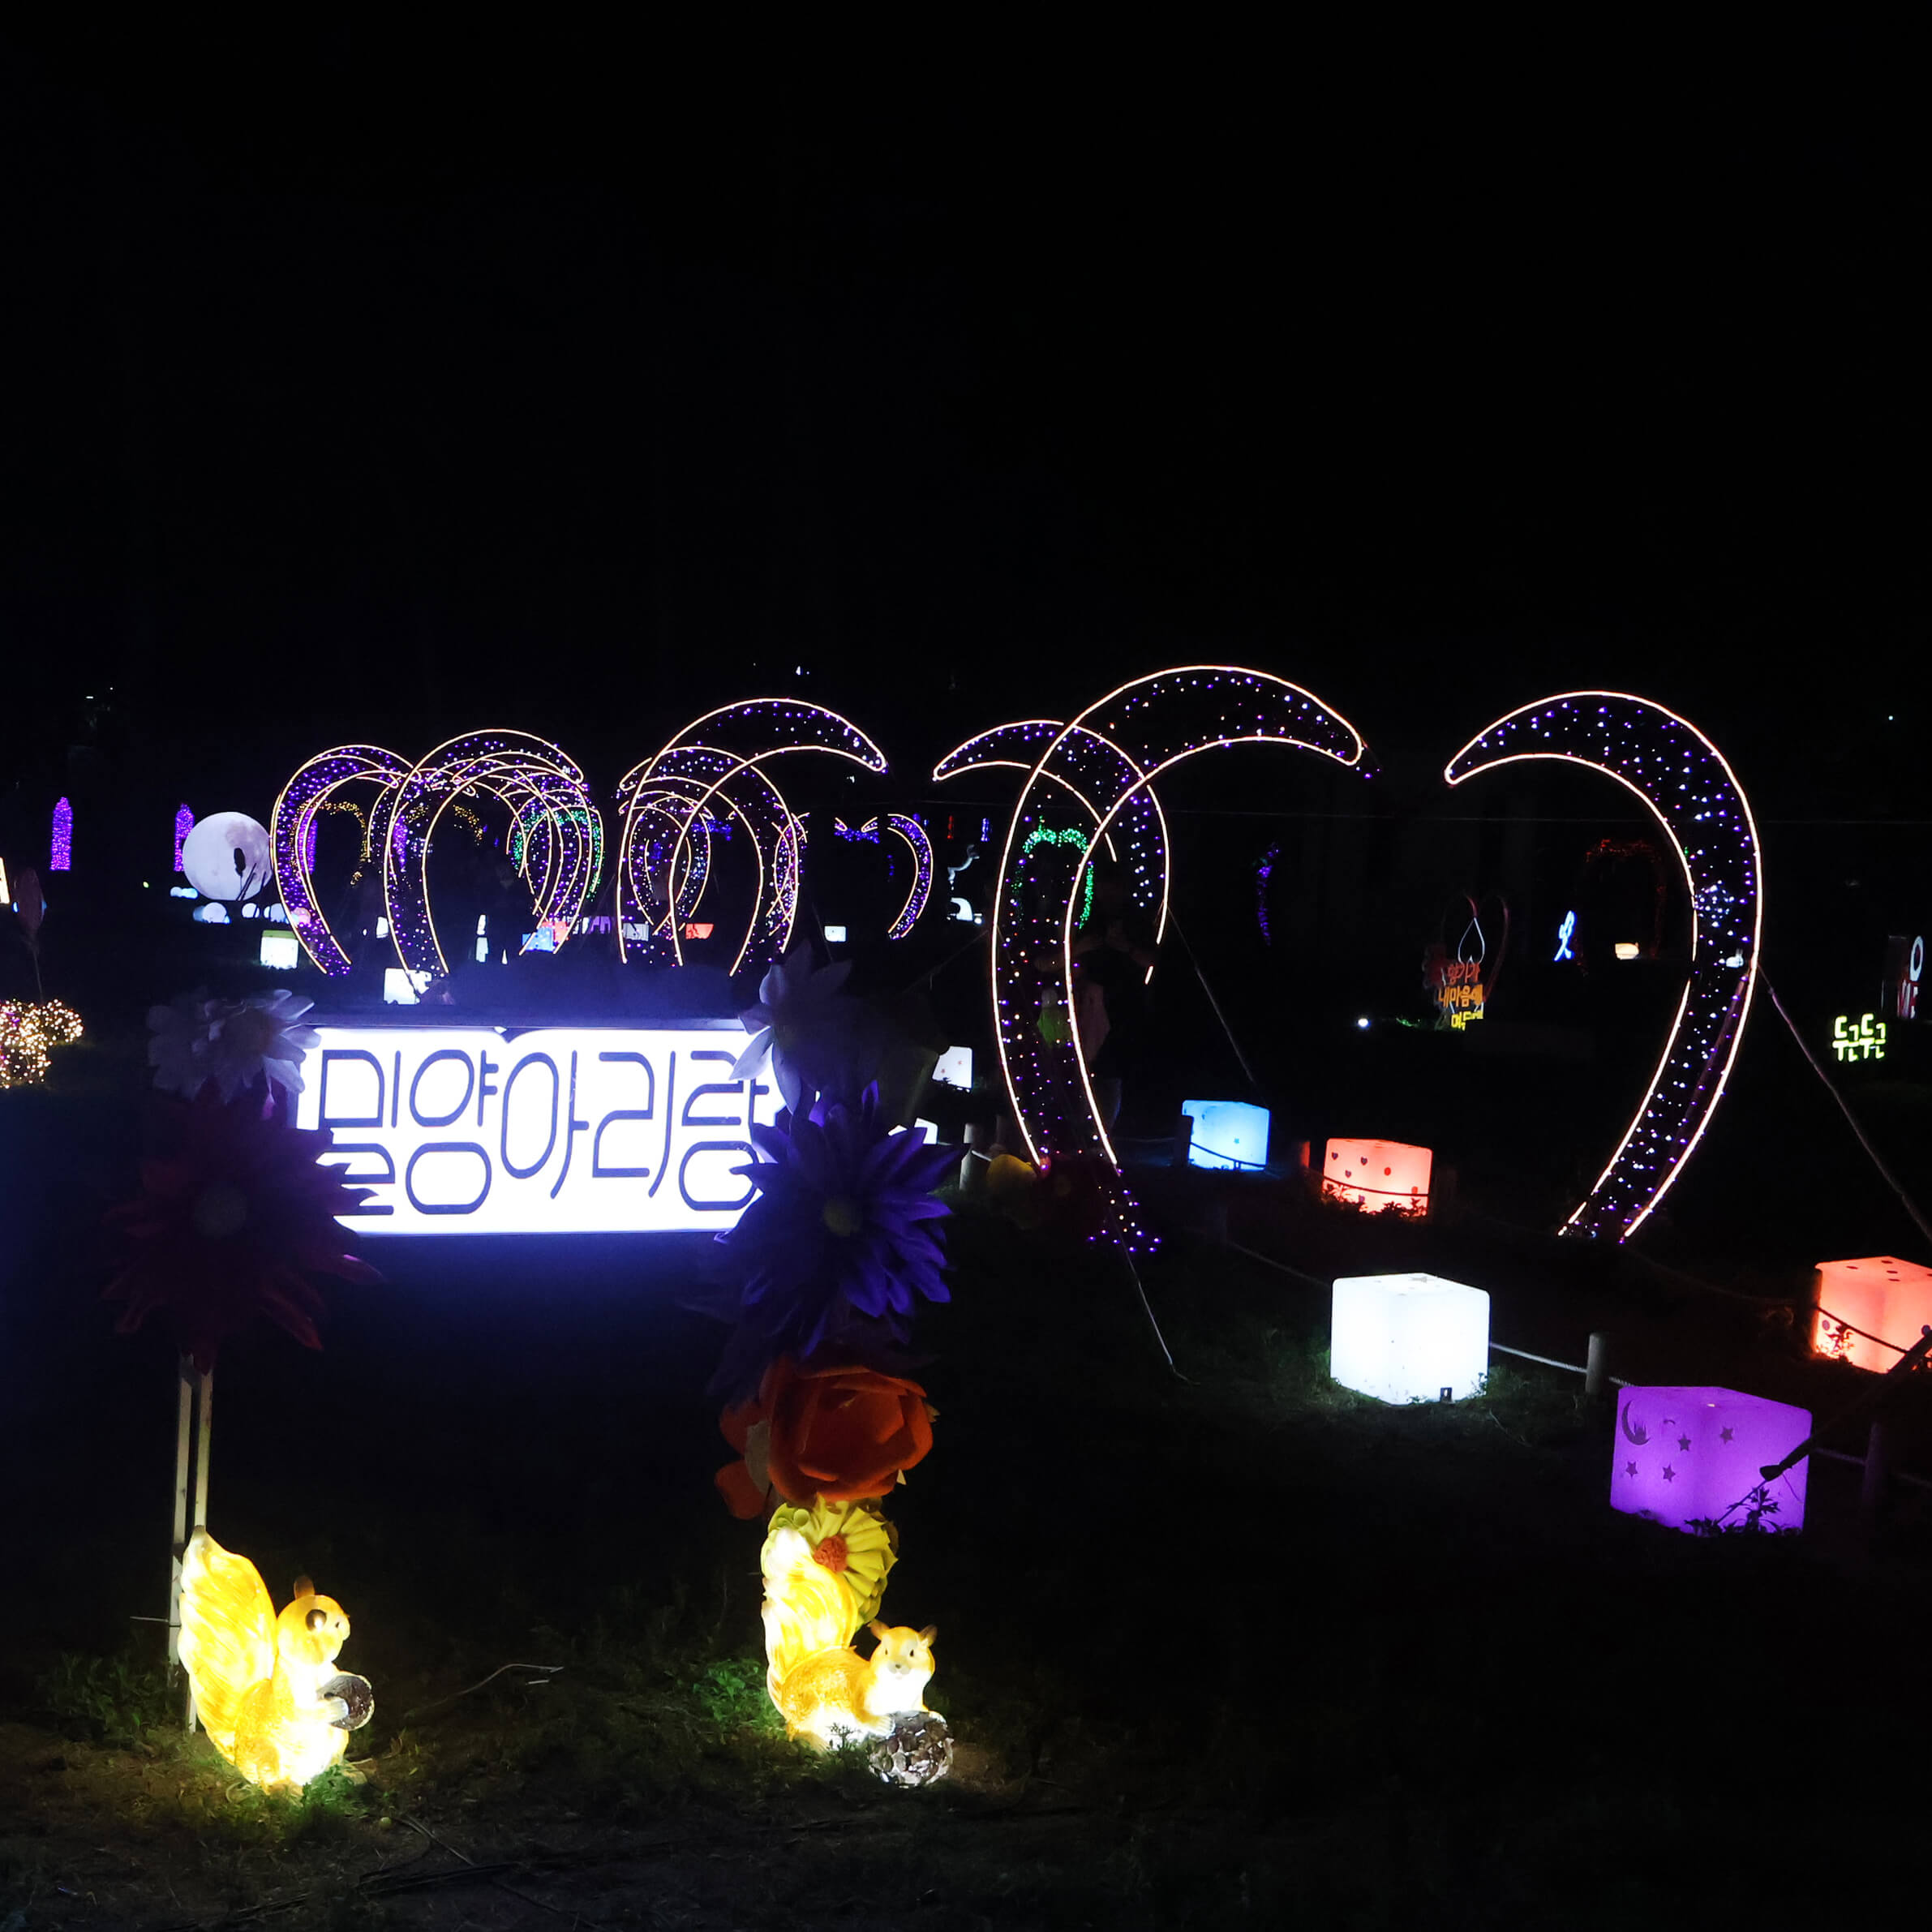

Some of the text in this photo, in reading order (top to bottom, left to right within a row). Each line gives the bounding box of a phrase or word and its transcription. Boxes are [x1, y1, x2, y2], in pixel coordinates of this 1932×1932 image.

[1438, 983, 1483, 1008] 내마음에
[1832, 1014, 1886, 1062] 두근두근
[319, 1049, 770, 1216] 밀양아리랑
